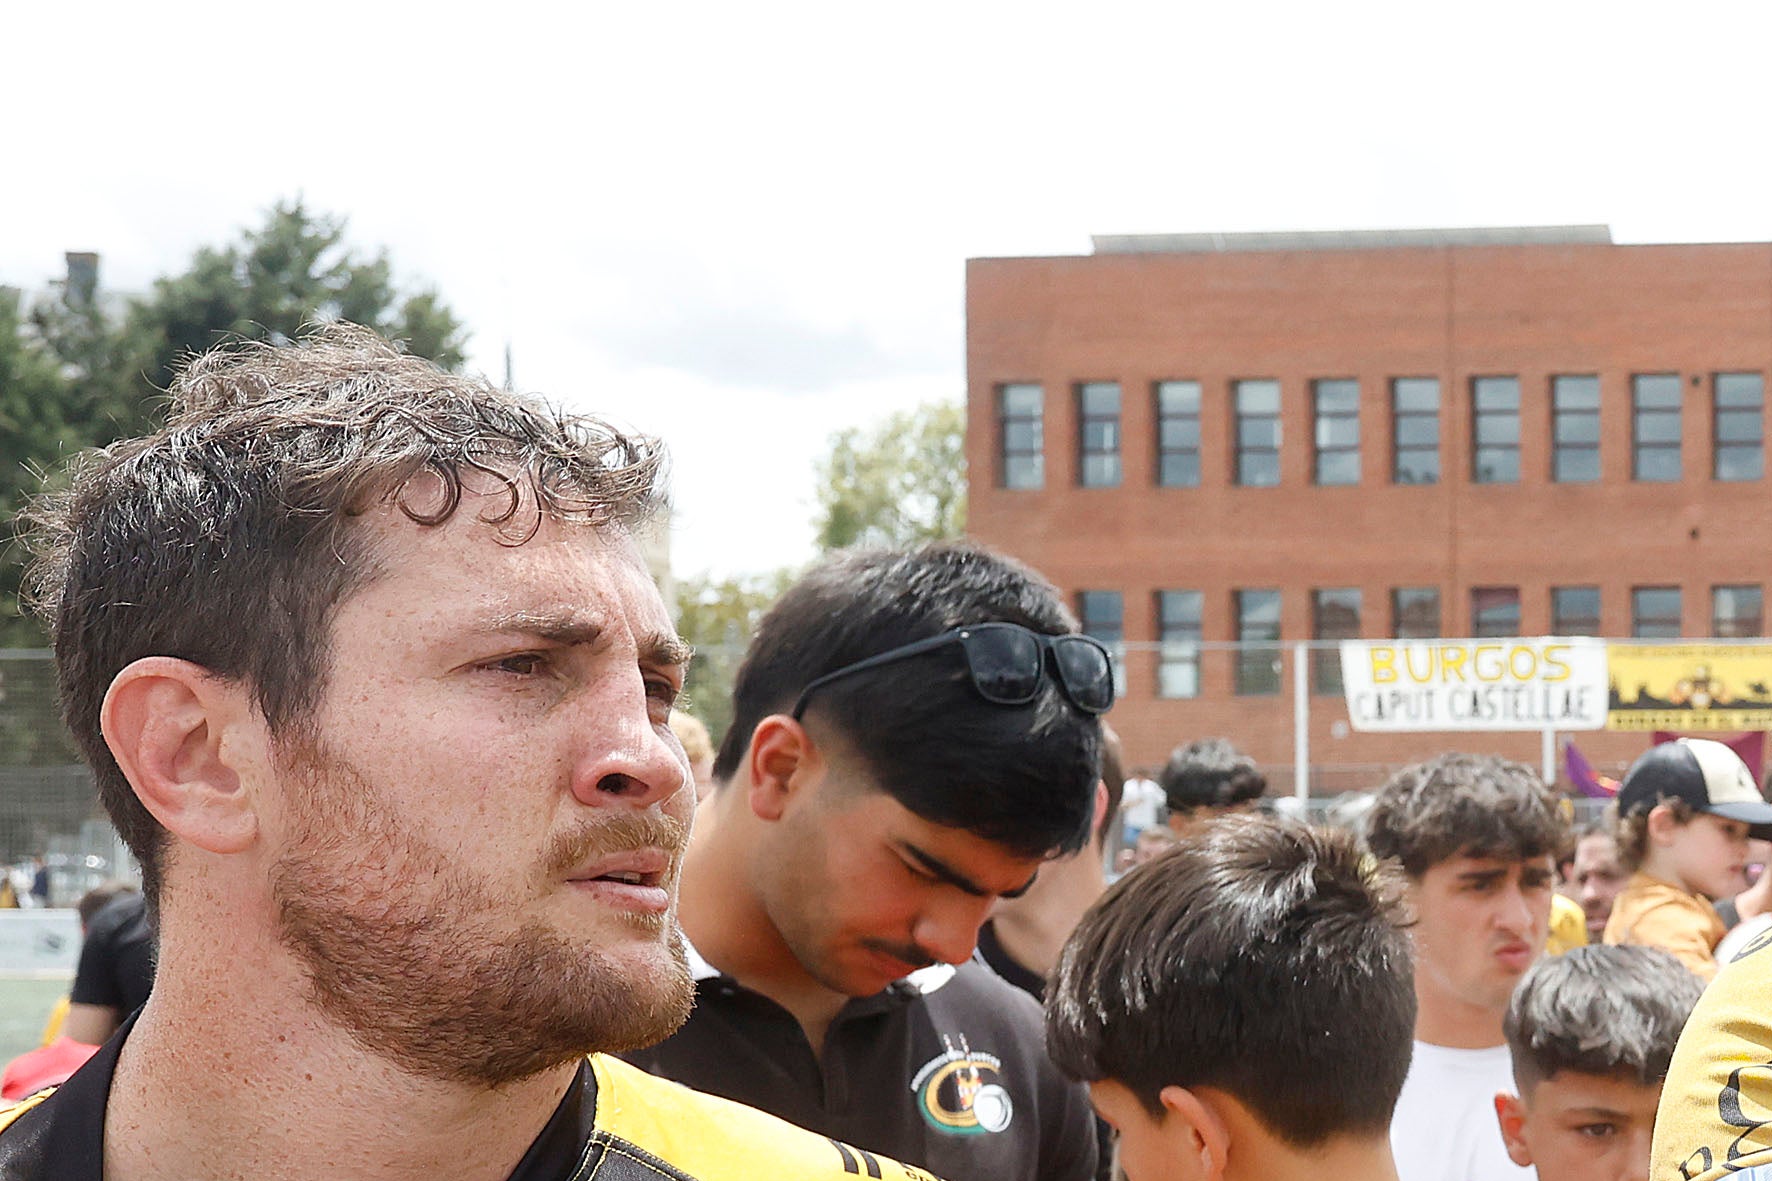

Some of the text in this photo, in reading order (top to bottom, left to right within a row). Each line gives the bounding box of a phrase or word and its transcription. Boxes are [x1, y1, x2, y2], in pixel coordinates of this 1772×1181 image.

[1370, 644, 1573, 684] BURGOS
[1353, 688, 1435, 722] CAPUT
[1449, 682, 1593, 722] CASTELLAE
